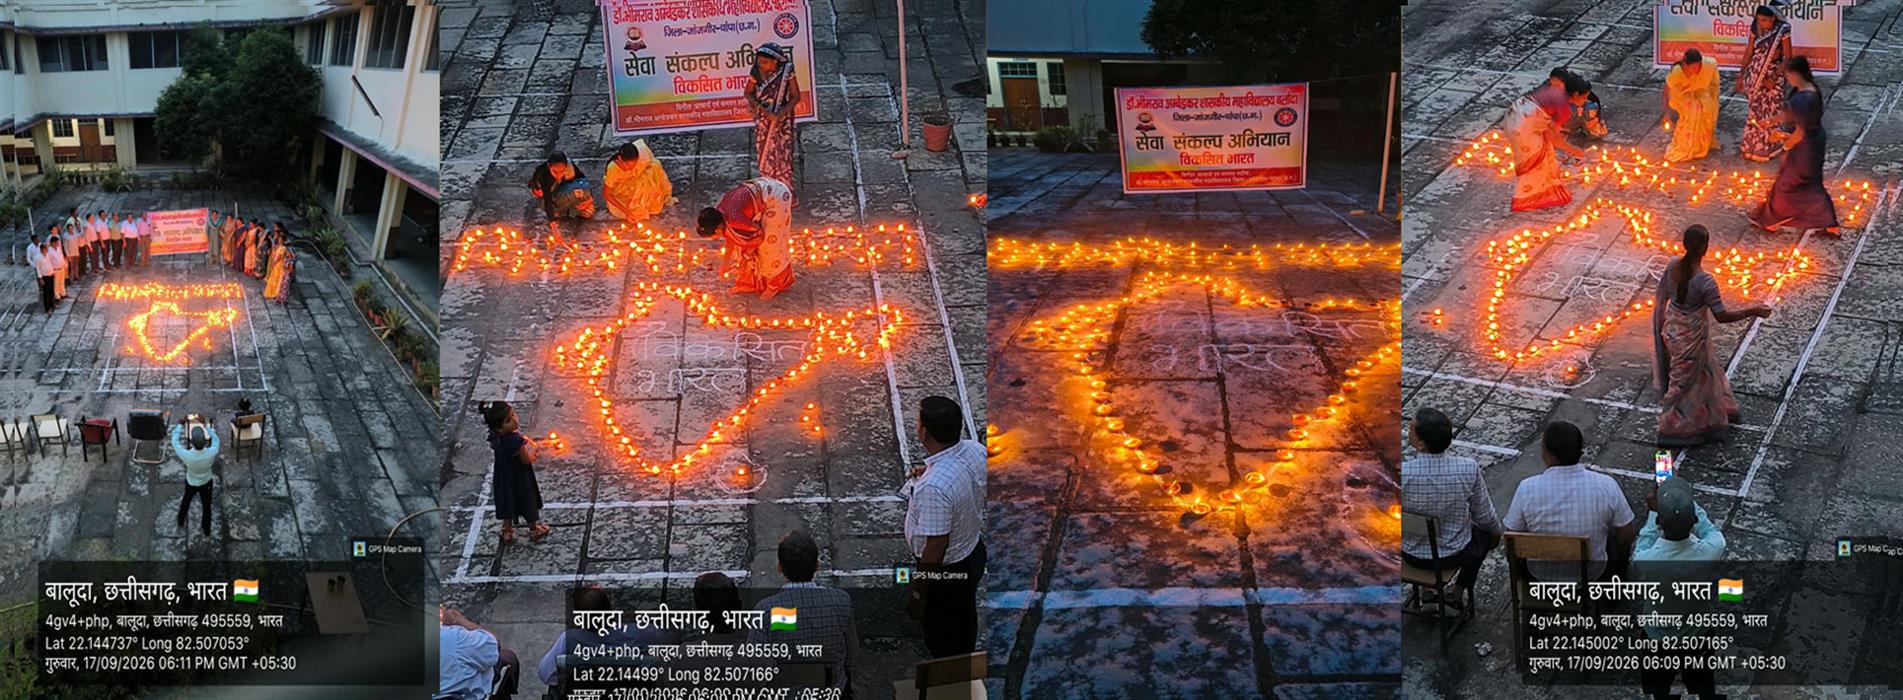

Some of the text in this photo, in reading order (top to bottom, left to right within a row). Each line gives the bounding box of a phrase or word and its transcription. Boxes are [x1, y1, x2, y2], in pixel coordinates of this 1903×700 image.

[1713, 18, 1750, 37] विकसि
[624, 52, 656, 76] सेवा
[665, 51, 719, 73] संकल्प
[674, 75, 749, 94] विकसित भार
[1135, 128, 1291, 151] सेवा संकल्प अभियान
[1180, 152, 1255, 166] विकसित भारत
